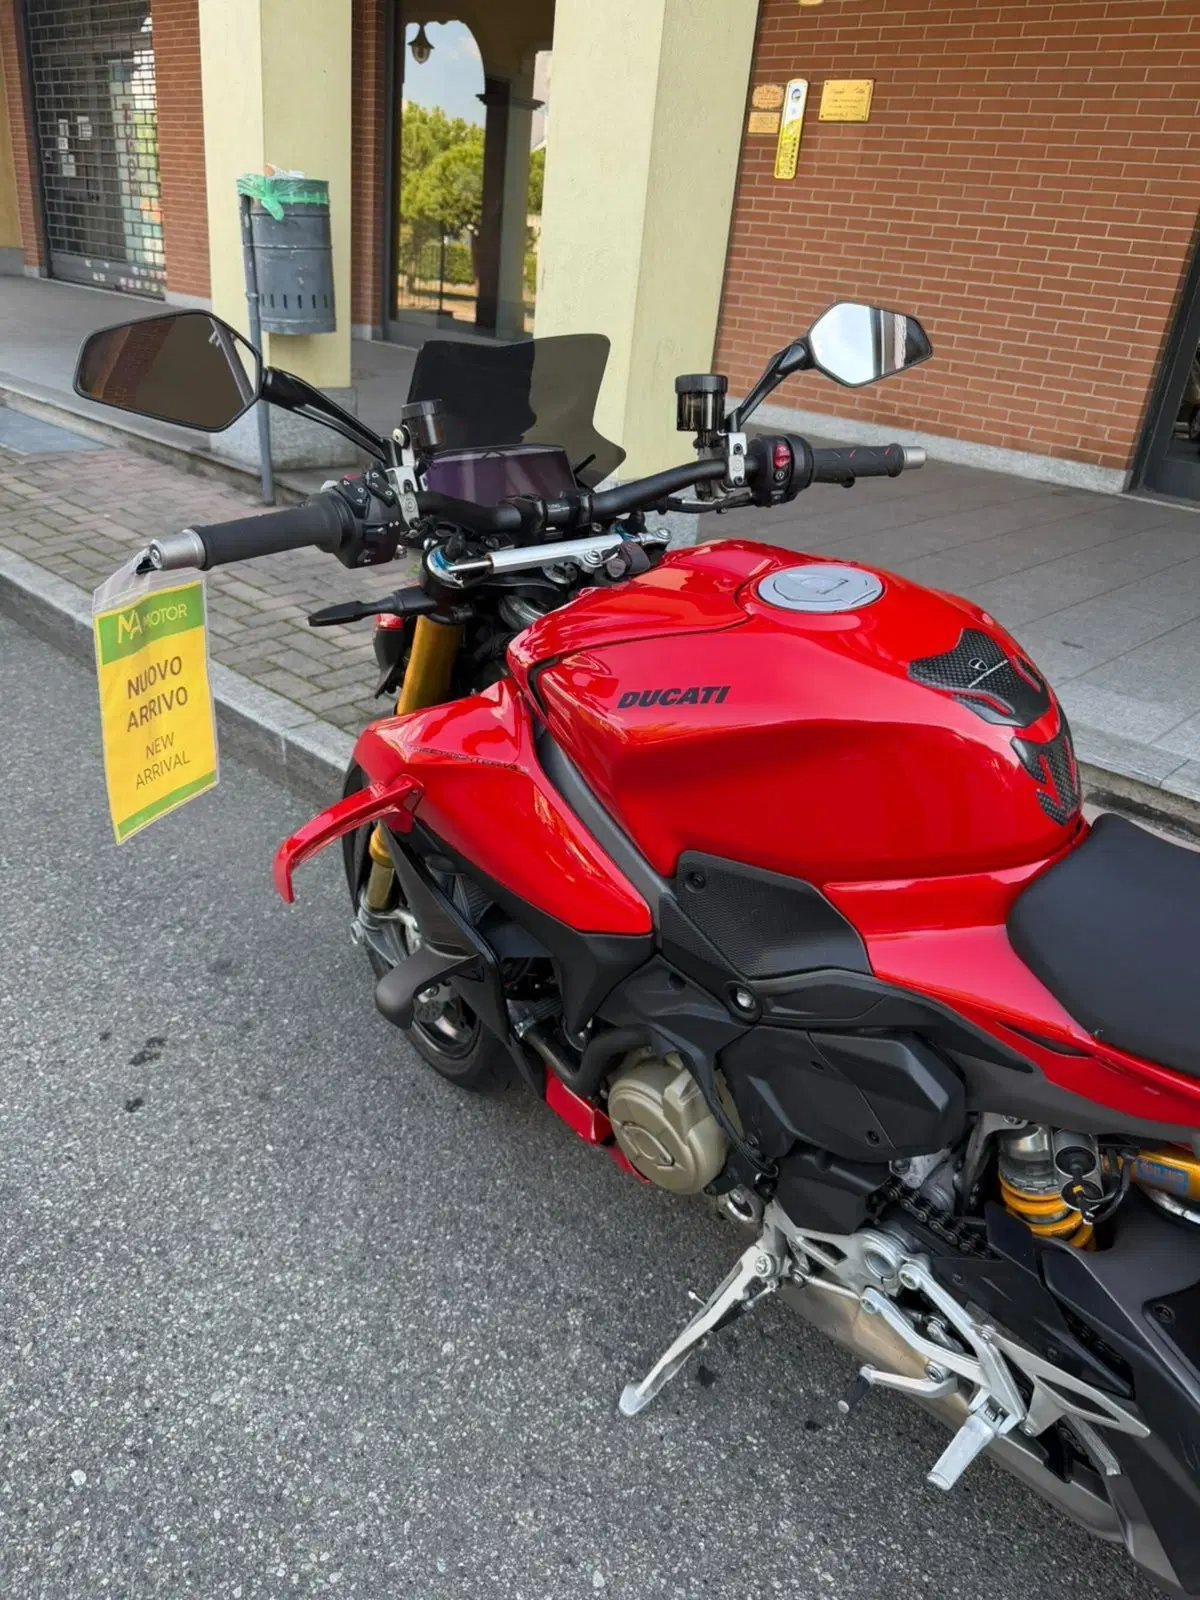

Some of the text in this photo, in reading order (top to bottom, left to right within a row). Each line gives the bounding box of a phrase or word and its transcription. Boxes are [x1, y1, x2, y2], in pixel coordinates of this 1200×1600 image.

[143, 603, 187, 628] MOTOR
[127, 656, 182, 699] NUOVO
[127, 686, 188, 732] ARRIVO
[617, 686, 731, 708] DUCATI
[146, 732, 174, 758] NEW
[136, 751, 191, 790] ARRIVAL
